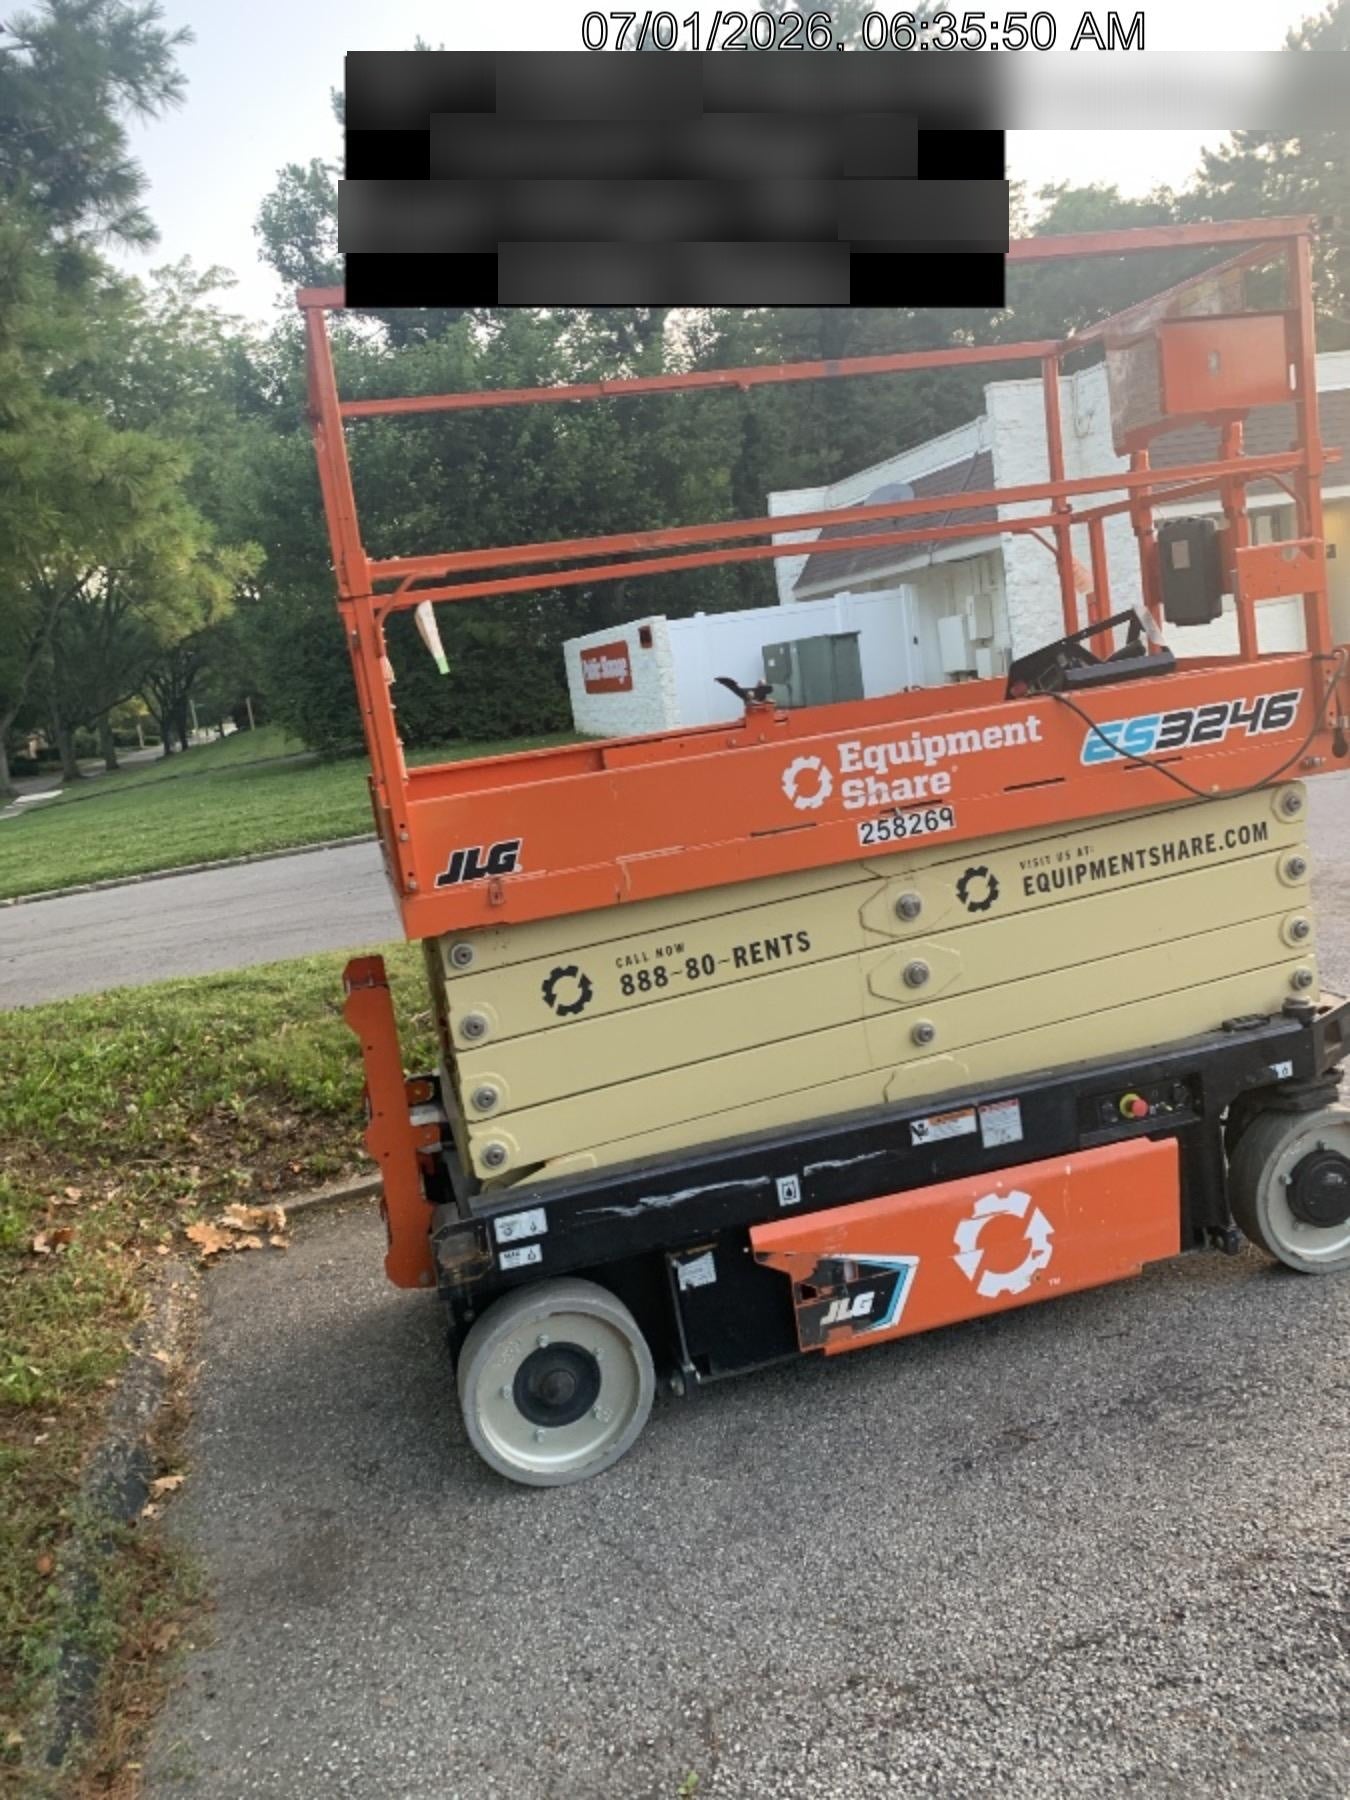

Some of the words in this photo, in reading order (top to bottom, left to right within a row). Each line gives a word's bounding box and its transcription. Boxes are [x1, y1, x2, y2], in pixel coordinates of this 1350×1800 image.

[836, 715, 1043, 776] Equipment
[1081, 688, 1303, 766] ES3246
[841, 771, 952, 810] Share
[859, 806, 956, 846] 258269
[434, 838, 524, 888] JLG
[1018, 854, 1051, 870] VISIT
[1056, 849, 1071, 862] US
[1023, 821, 1269, 897] EQUIPMENTSHARE.COM
[615, 952, 650, 969] CALL
[655, 942, 686, 959] NOW
[619, 930, 812, 996] 888-80-RENTS
[819, 1291, 876, 1326] JLG
